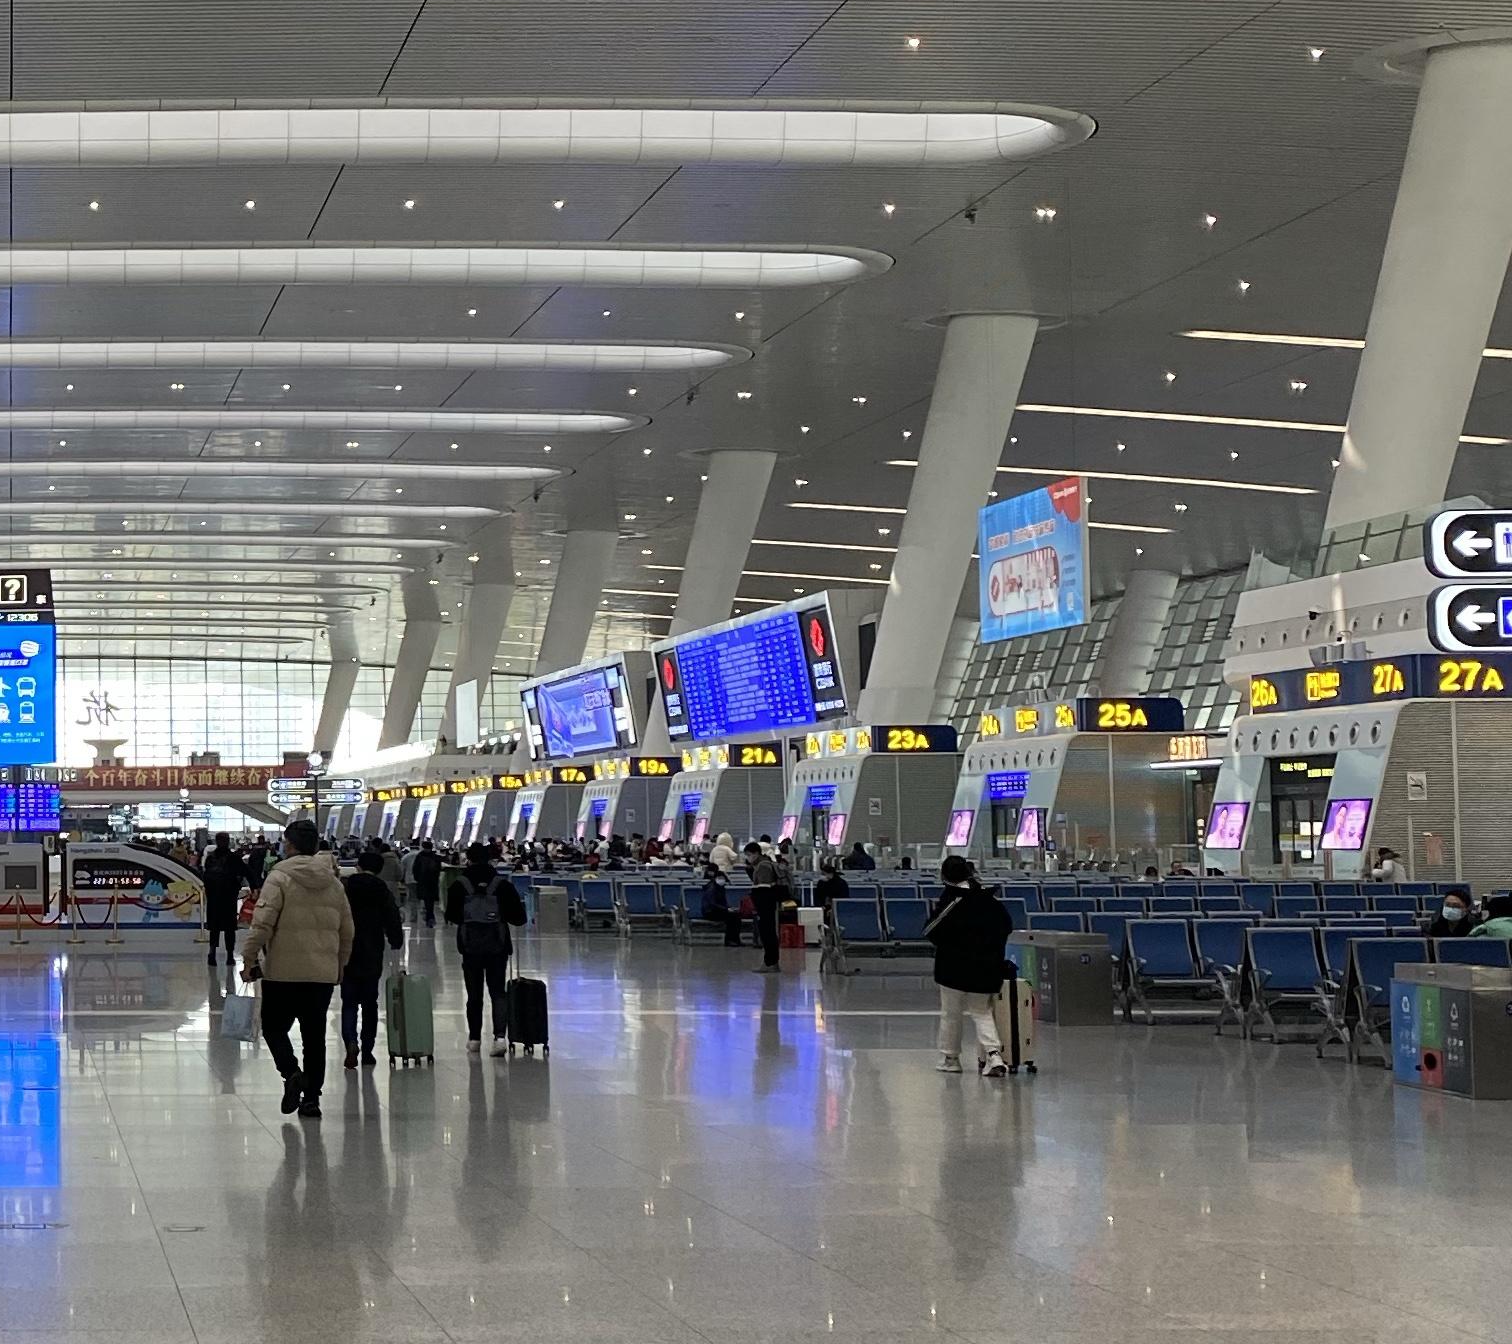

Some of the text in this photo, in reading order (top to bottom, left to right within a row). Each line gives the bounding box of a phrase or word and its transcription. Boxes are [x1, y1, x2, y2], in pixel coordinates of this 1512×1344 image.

[7, 613, 39, 622] 12306
[1372, 664, 1405, 694] 27A
[1438, 661, 1504, 692] 27A
[1251, 679, 1278, 707] 26A
[1055, 704, 1075, 728] 25A
[1097, 702, 1148, 728] 25A
[888, 729, 929, 750] 23A
[639, 759, 670, 774] 19A
[741, 747, 776, 765] 21A
[499, 776, 523, 788] 15A
[560, 768, 587, 783] 17A
